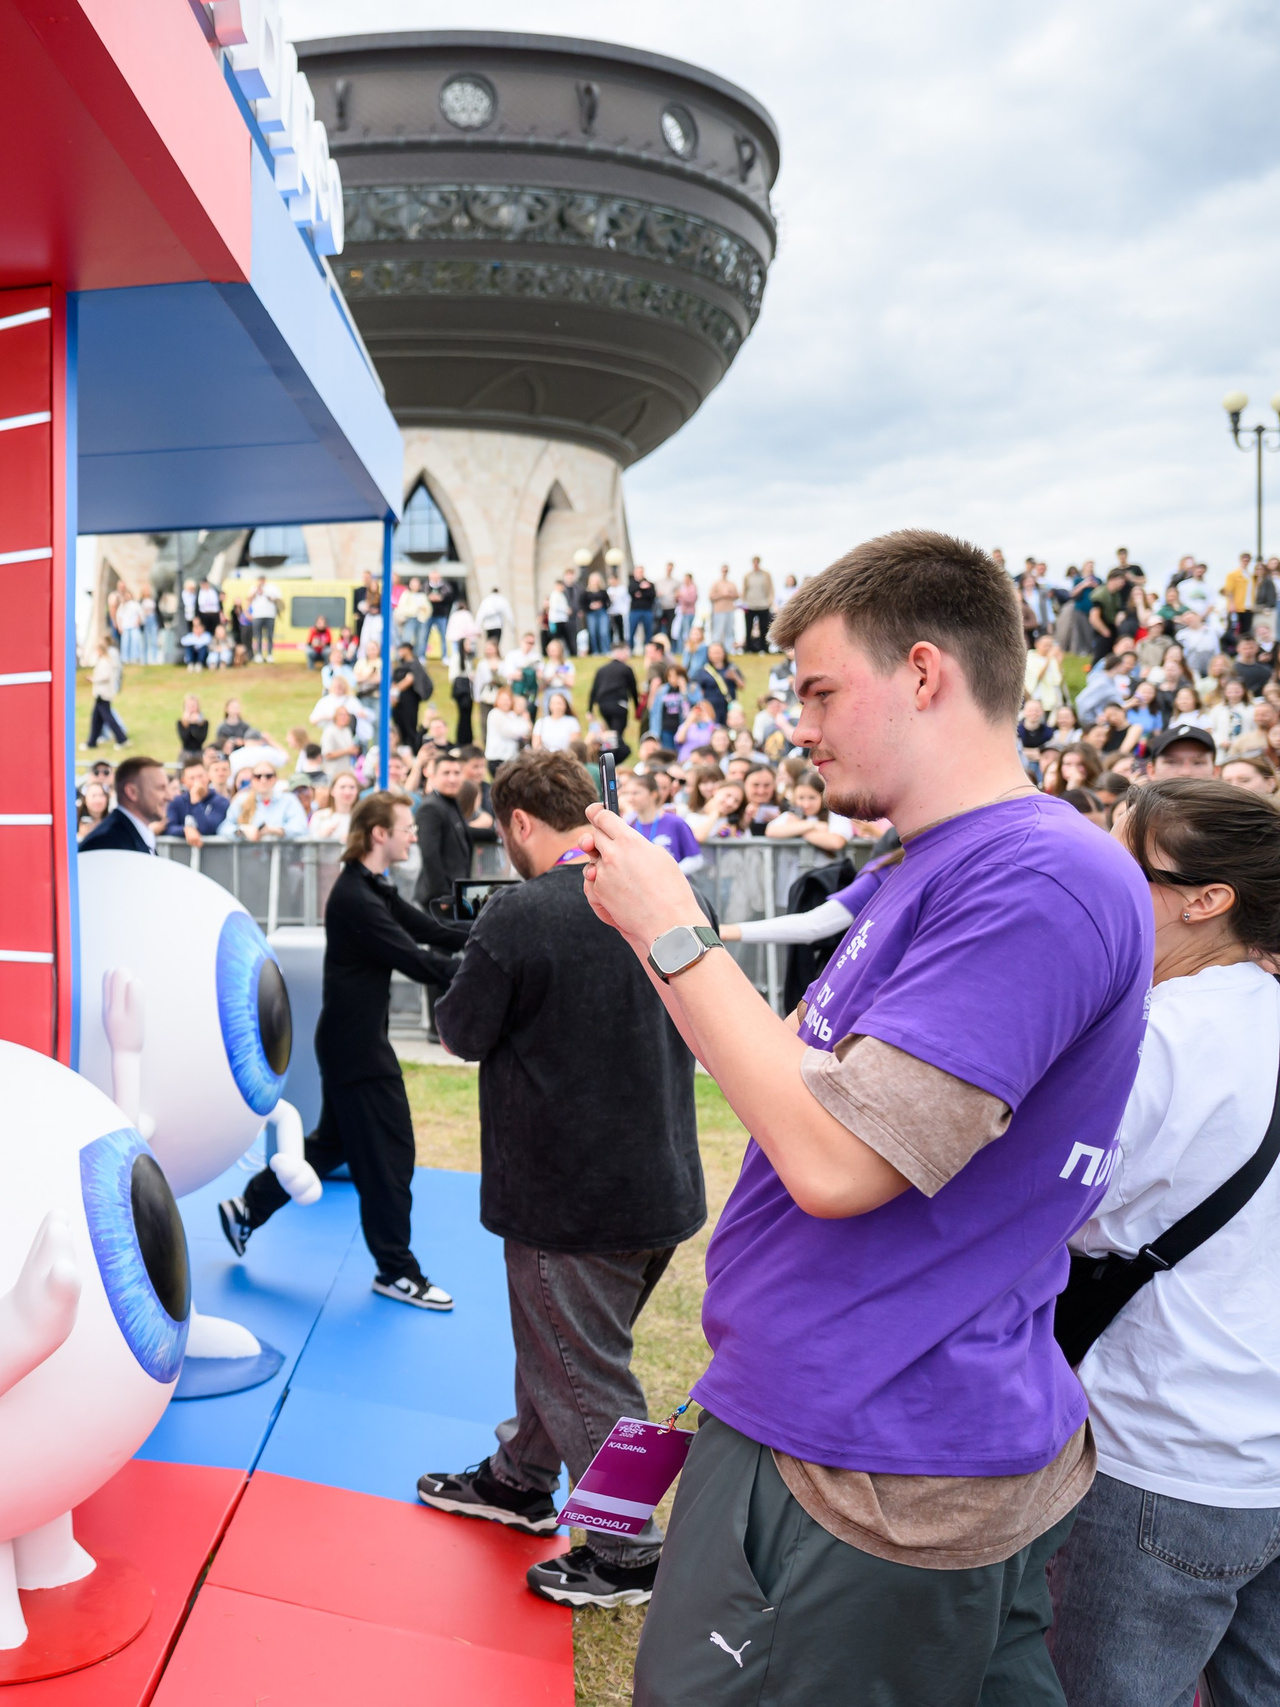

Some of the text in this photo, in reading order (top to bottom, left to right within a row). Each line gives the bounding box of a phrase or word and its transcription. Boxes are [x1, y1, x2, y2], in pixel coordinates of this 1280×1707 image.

[858, 919, 875, 937] K
[846, 934, 868, 961] st
[607, 1441, 647, 1454] КАЗАНЬ
[563, 1511, 631, 1531] ПЕРСОНАЛ
